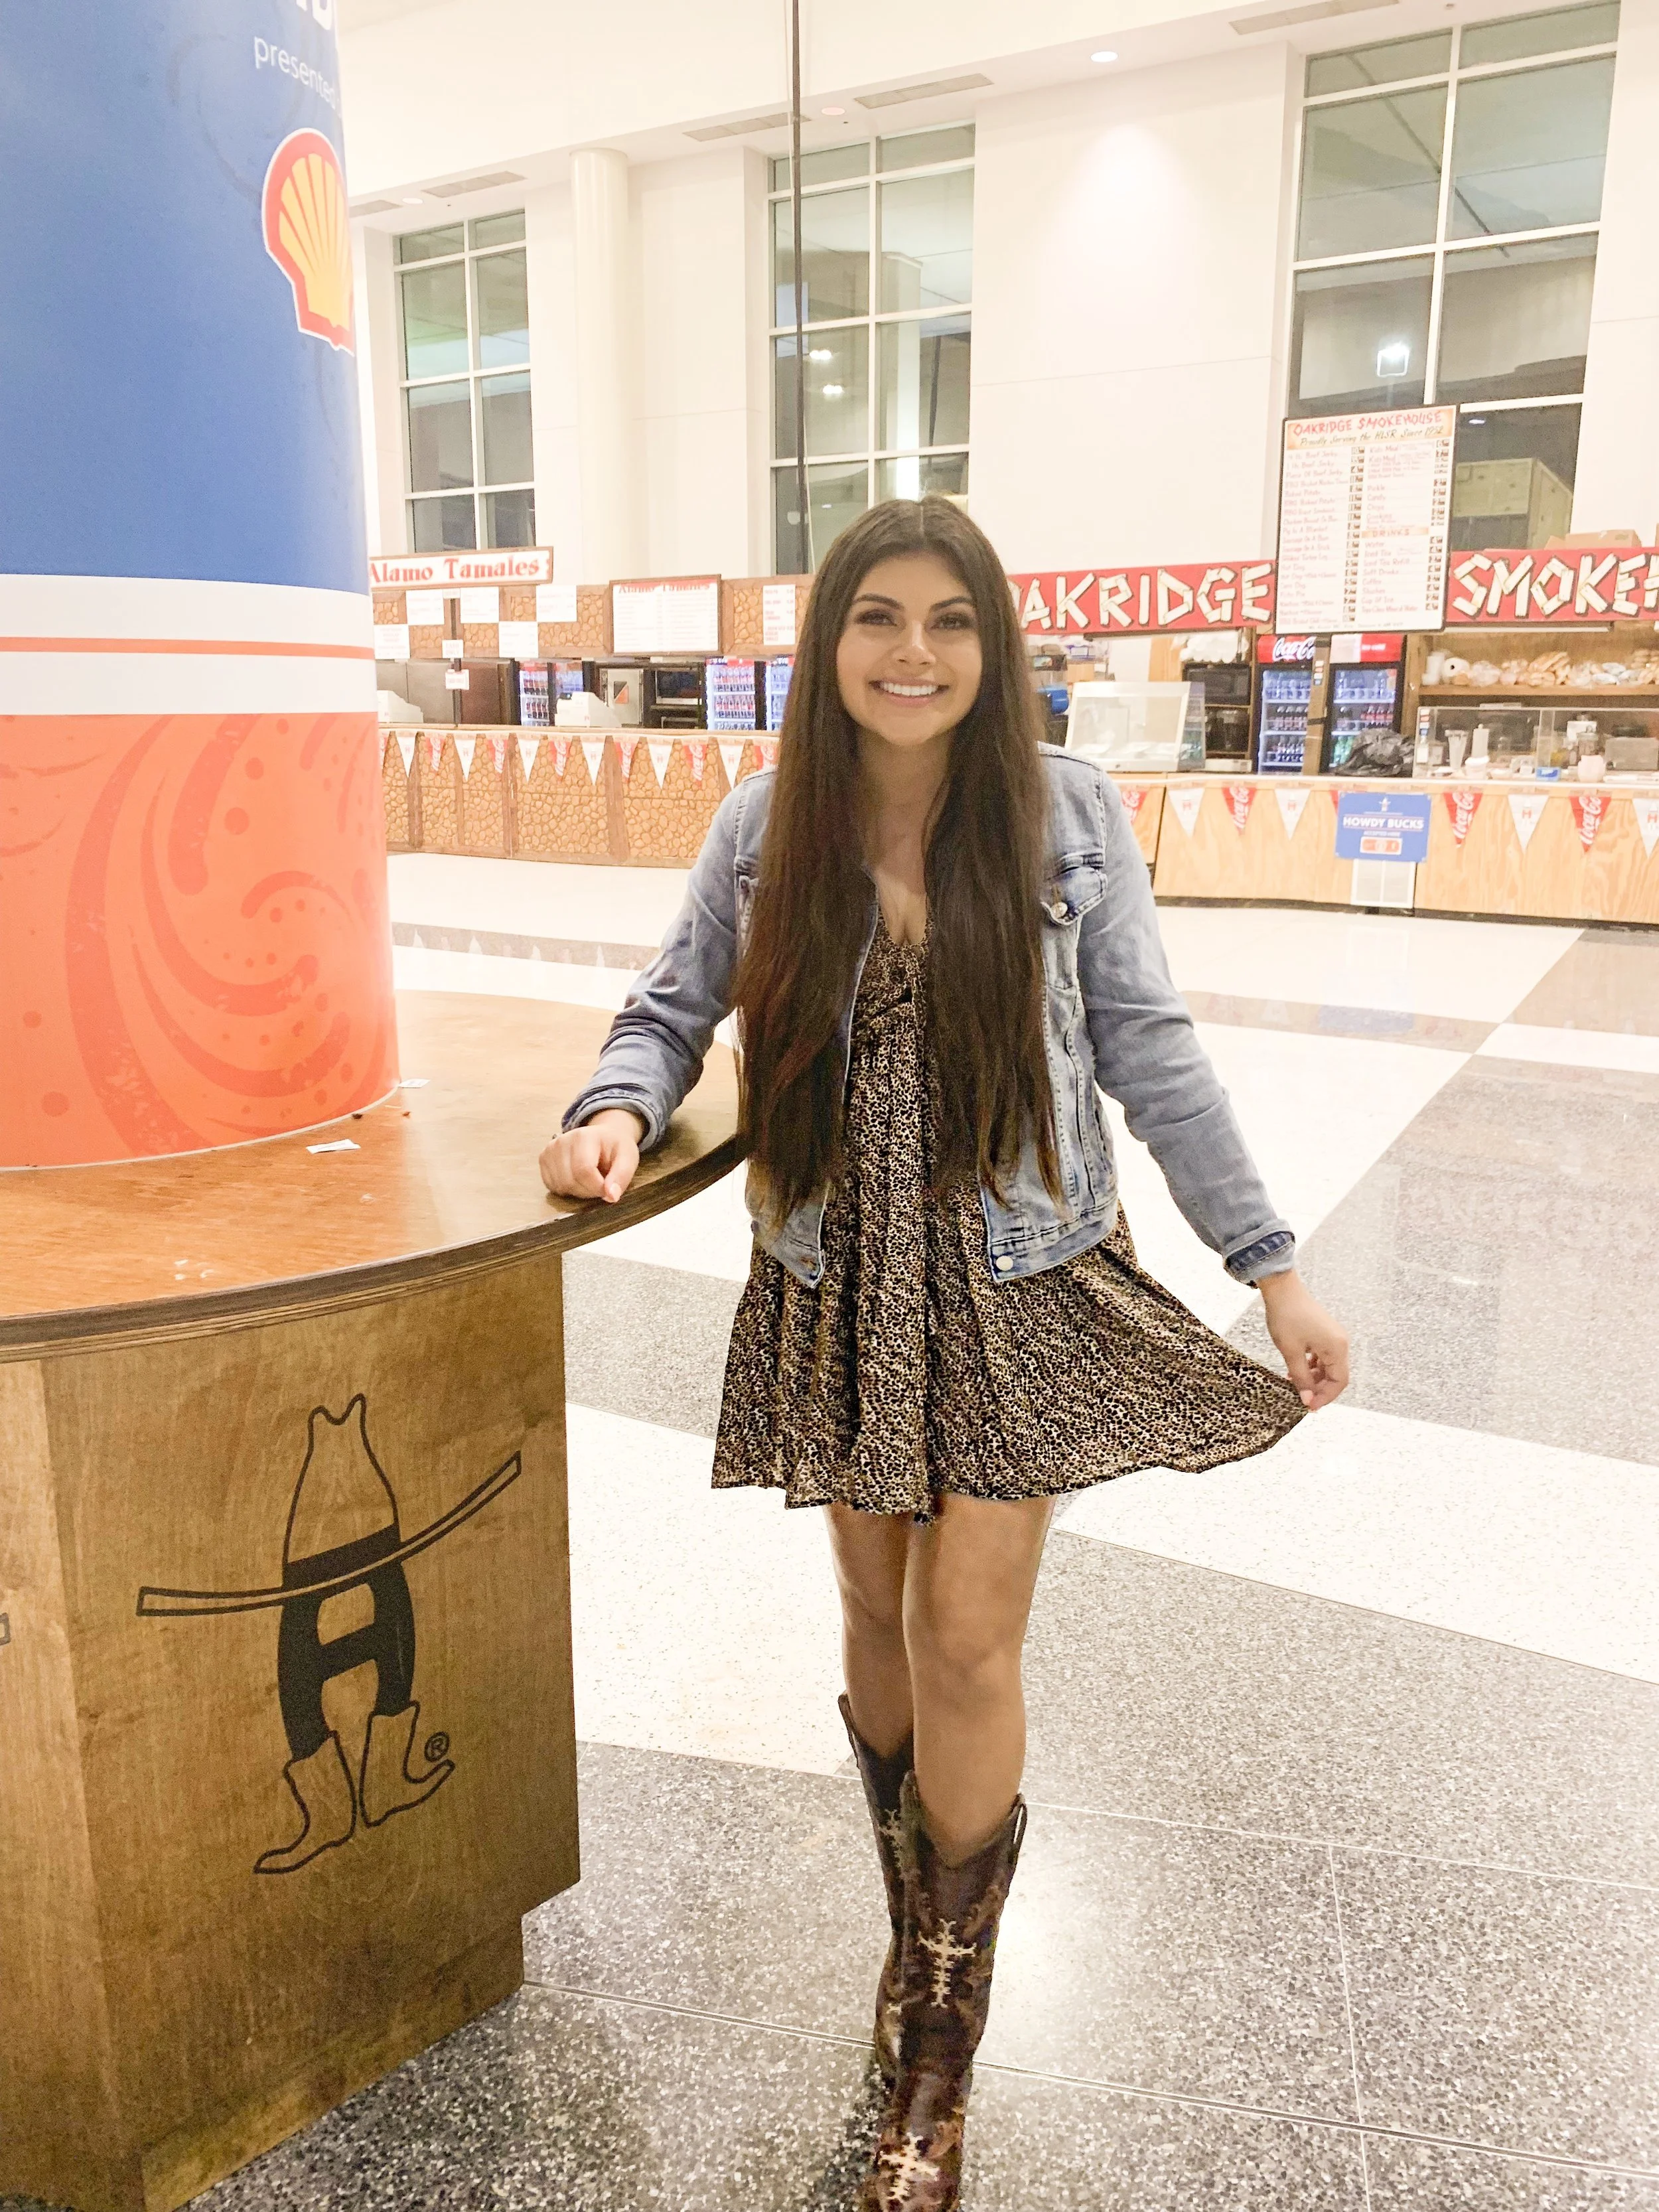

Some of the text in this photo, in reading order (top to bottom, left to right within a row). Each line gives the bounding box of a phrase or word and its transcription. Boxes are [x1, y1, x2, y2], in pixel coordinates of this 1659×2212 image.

[1293, 411, 1442, 437] OAKRIDGE SMOKEHOUSE
[1300, 436, 1327, 446] Proudly
[1330, 435, 1356, 445] Serving
[1360, 433, 1371, 442] the
[1375, 429, 1397, 439] HLSR
[1401, 428, 1422, 438] Since
[1372, 528, 1409, 538] DRINKS
[370, 555, 540, 583] Alamo Tamales
[1006, 563, 1272, 630] AKRIDGE
[1272, 636, 1317, 662] Coca-Co
[1342, 816, 1424, 830] HOWDY BUCKS
